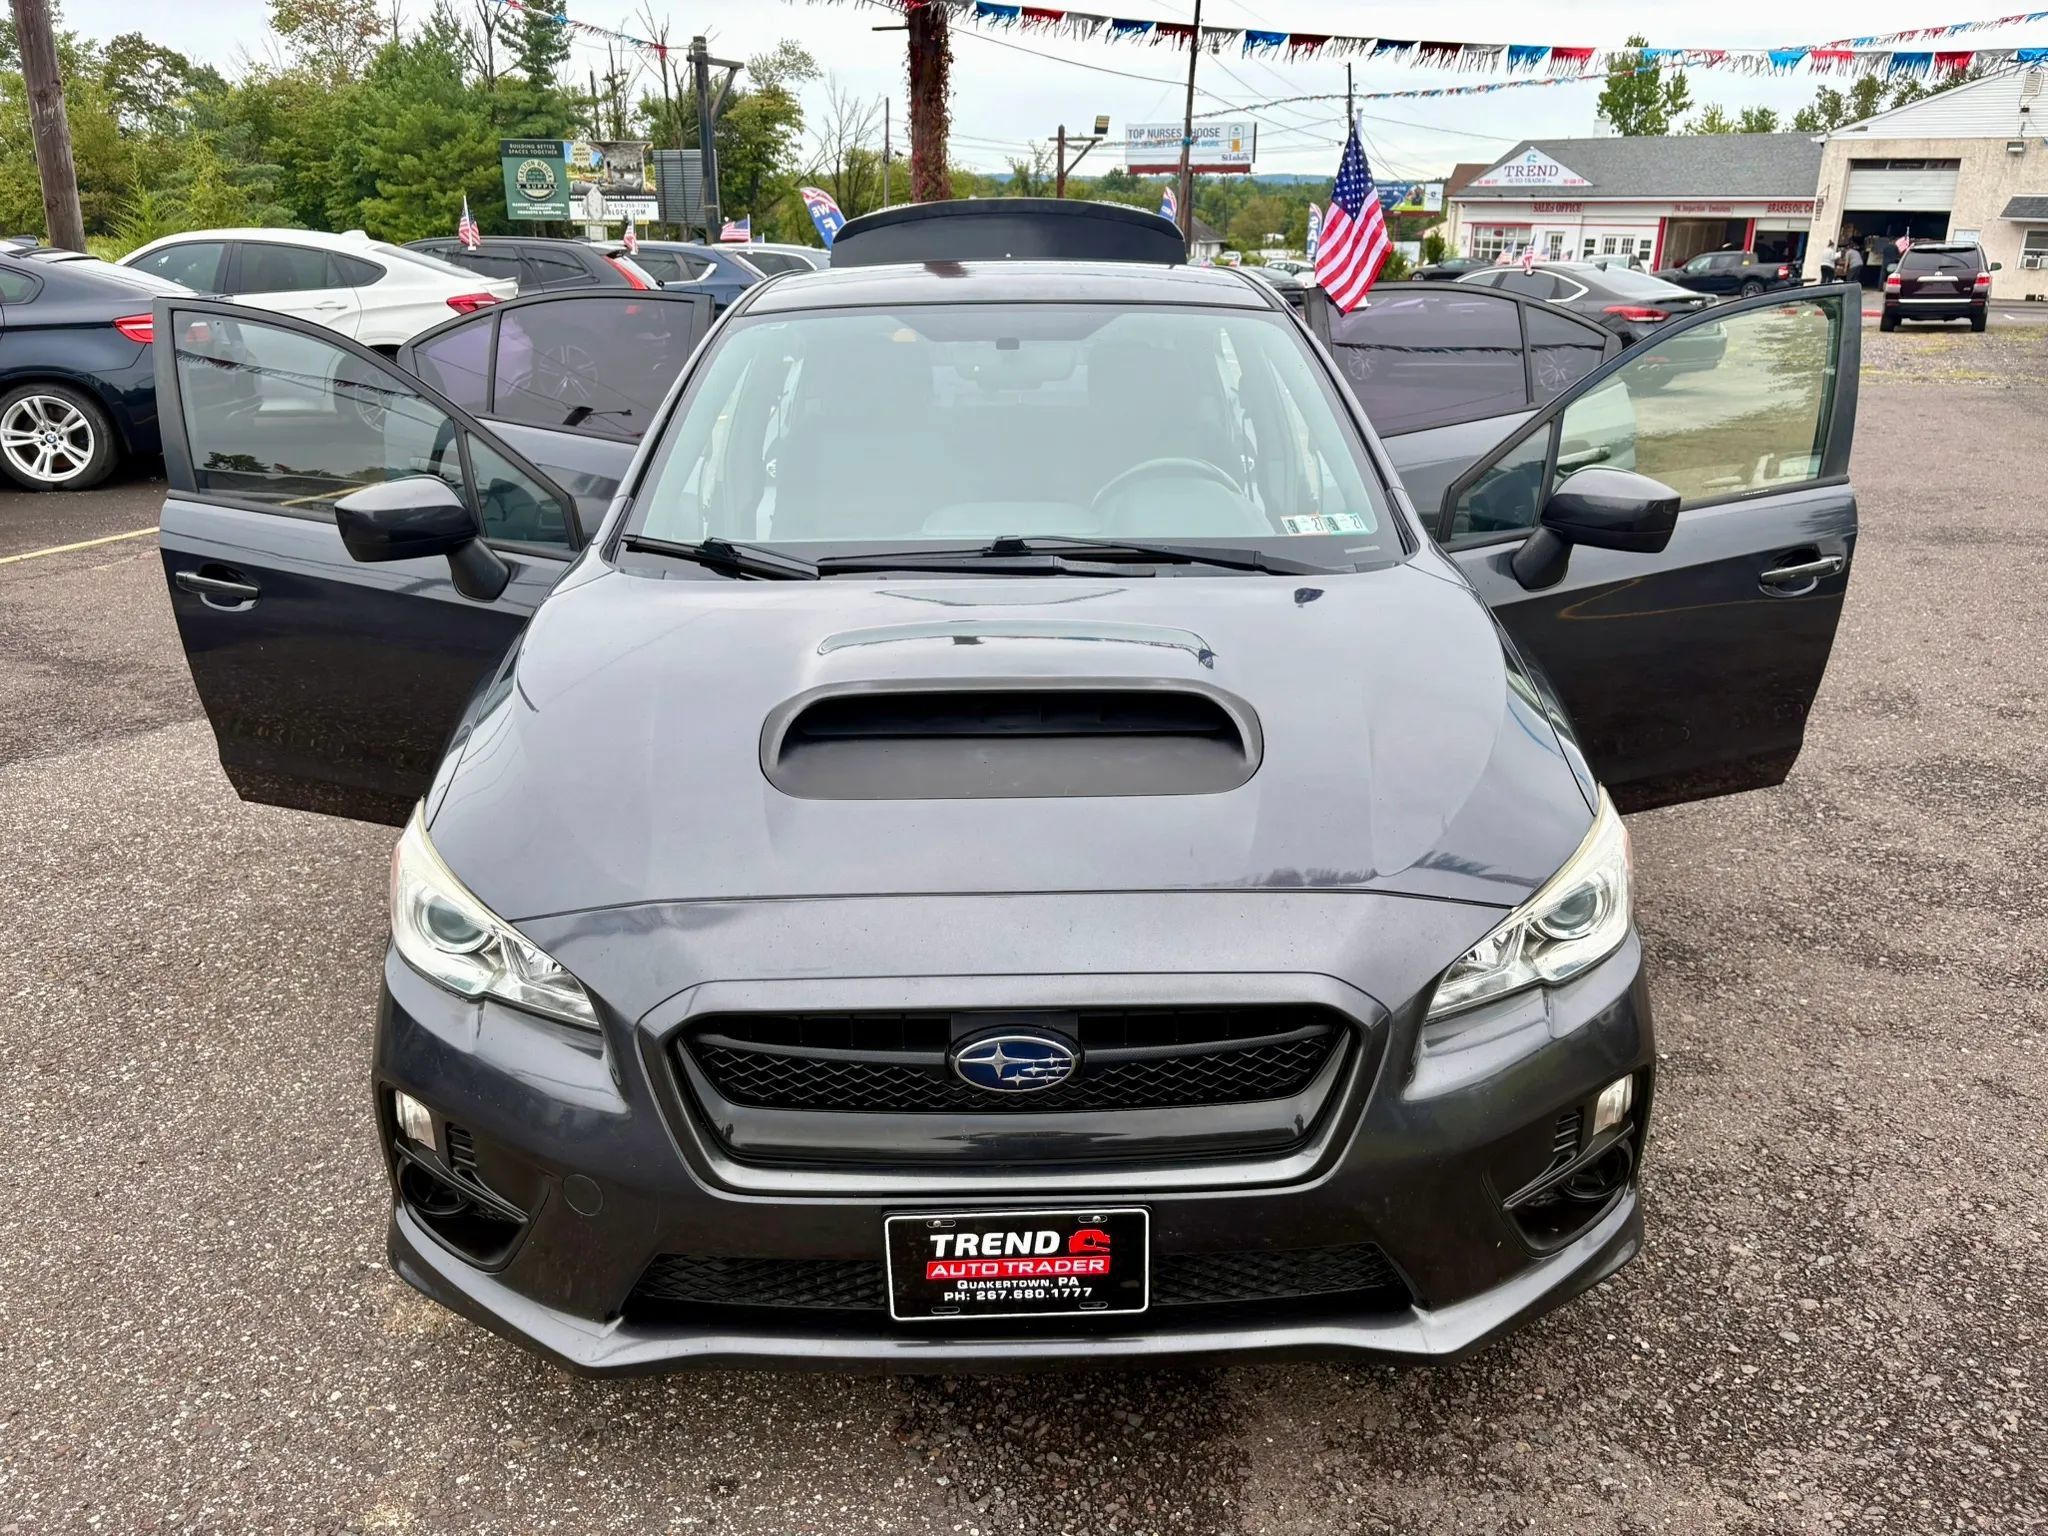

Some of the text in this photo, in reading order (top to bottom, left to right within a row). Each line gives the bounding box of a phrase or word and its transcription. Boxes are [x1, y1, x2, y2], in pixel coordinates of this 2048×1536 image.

[1128, 127, 1221, 139] TOP NURSES HOOSE
[1504, 164, 1559, 178] TREND
[1533, 202, 1583, 213] SALES OFFICE
[1768, 202, 1791, 213] BRAKES
[929, 1230, 1061, 1258] TREND
[931, 1259, 1105, 1277] AUTO TRADER
[1058, 1276, 1080, 1287] PA
[944, 1286, 1093, 1302] PH: 267.680.1777
